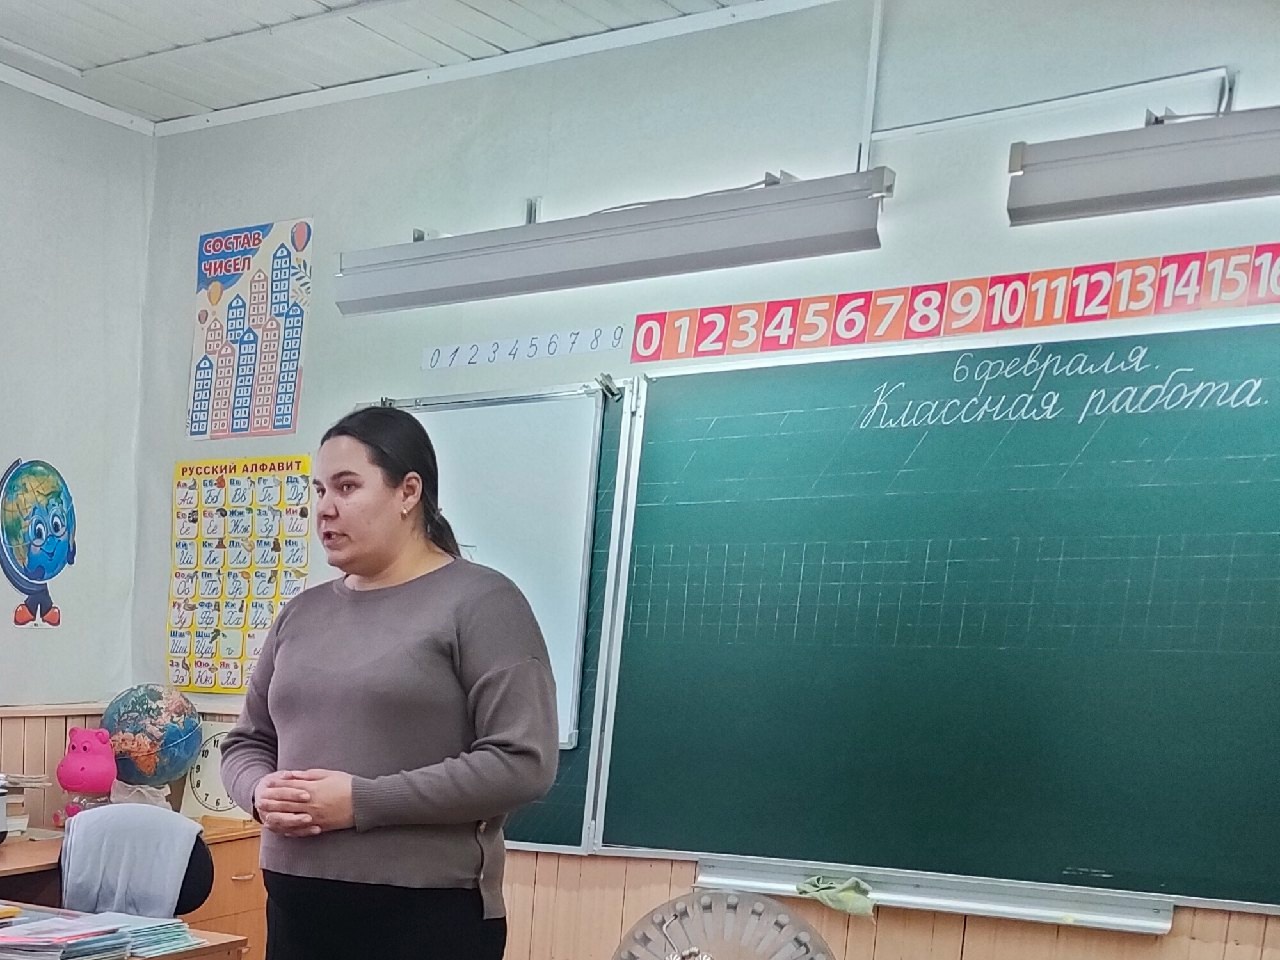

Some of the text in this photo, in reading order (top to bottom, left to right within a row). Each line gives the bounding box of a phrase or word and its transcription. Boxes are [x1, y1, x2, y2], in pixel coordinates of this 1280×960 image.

[204, 231, 262, 254] СОСТАВ
[203, 256, 251, 276] ЧИСЕЛ
[635, 320, 661, 357] 0
[674, 317, 690, 353] 1
[697, 313, 725, 352] 2
[731, 309, 759, 348] 3
[764, 306, 794, 345] 4
[799, 302, 830, 342] 5
[835, 298, 866, 339] 6
[873, 296, 905, 336] 7
[908, 290, 941, 333] 8
[951, 286, 982, 329] 9
[988, 281, 1026, 325] 10
[1031, 275, 1068, 321] 11
[1072, 270, 1113, 317] 12
[1116, 265, 1156, 312] 13
[1161, 260, 1201, 308] 14
[1207, 254, 1251, 302] 15
[429, 325, 624, 368] 0 1 2 3 4 5 6 7 8 9
[953, 344, 1161, 396] 6 февраля.
[860, 368, 1269, 429] Классная работа.
[181, 461, 302, 476] РУССКИЙ АЛФАВИТ
[202, 749, 209, 758] 10
